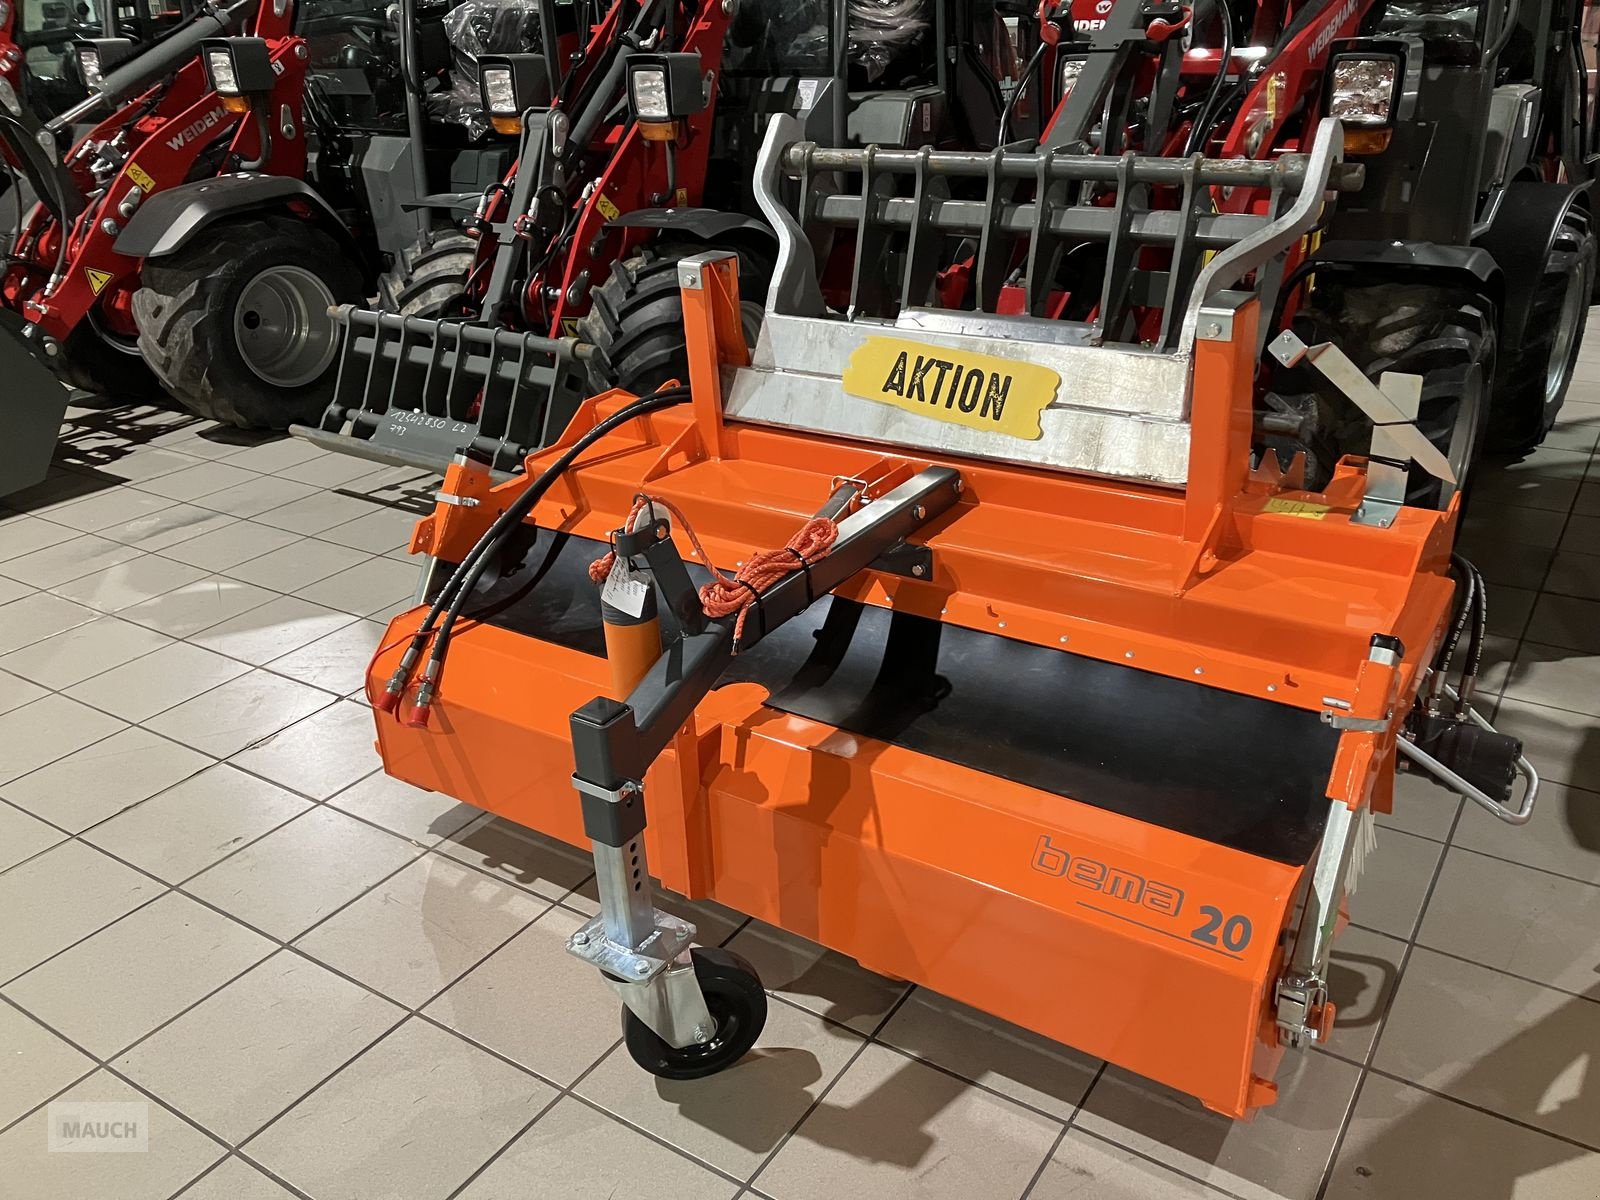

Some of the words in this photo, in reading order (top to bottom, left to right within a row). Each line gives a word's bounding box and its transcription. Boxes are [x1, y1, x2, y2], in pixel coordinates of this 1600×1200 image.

[166, 106, 229, 151] WEIDEM
[882, 351, 1013, 421] AKTION
[389, 424, 407, 436] 793
[1031, 835, 1185, 917] bema
[1190, 905, 1252, 952] 20
